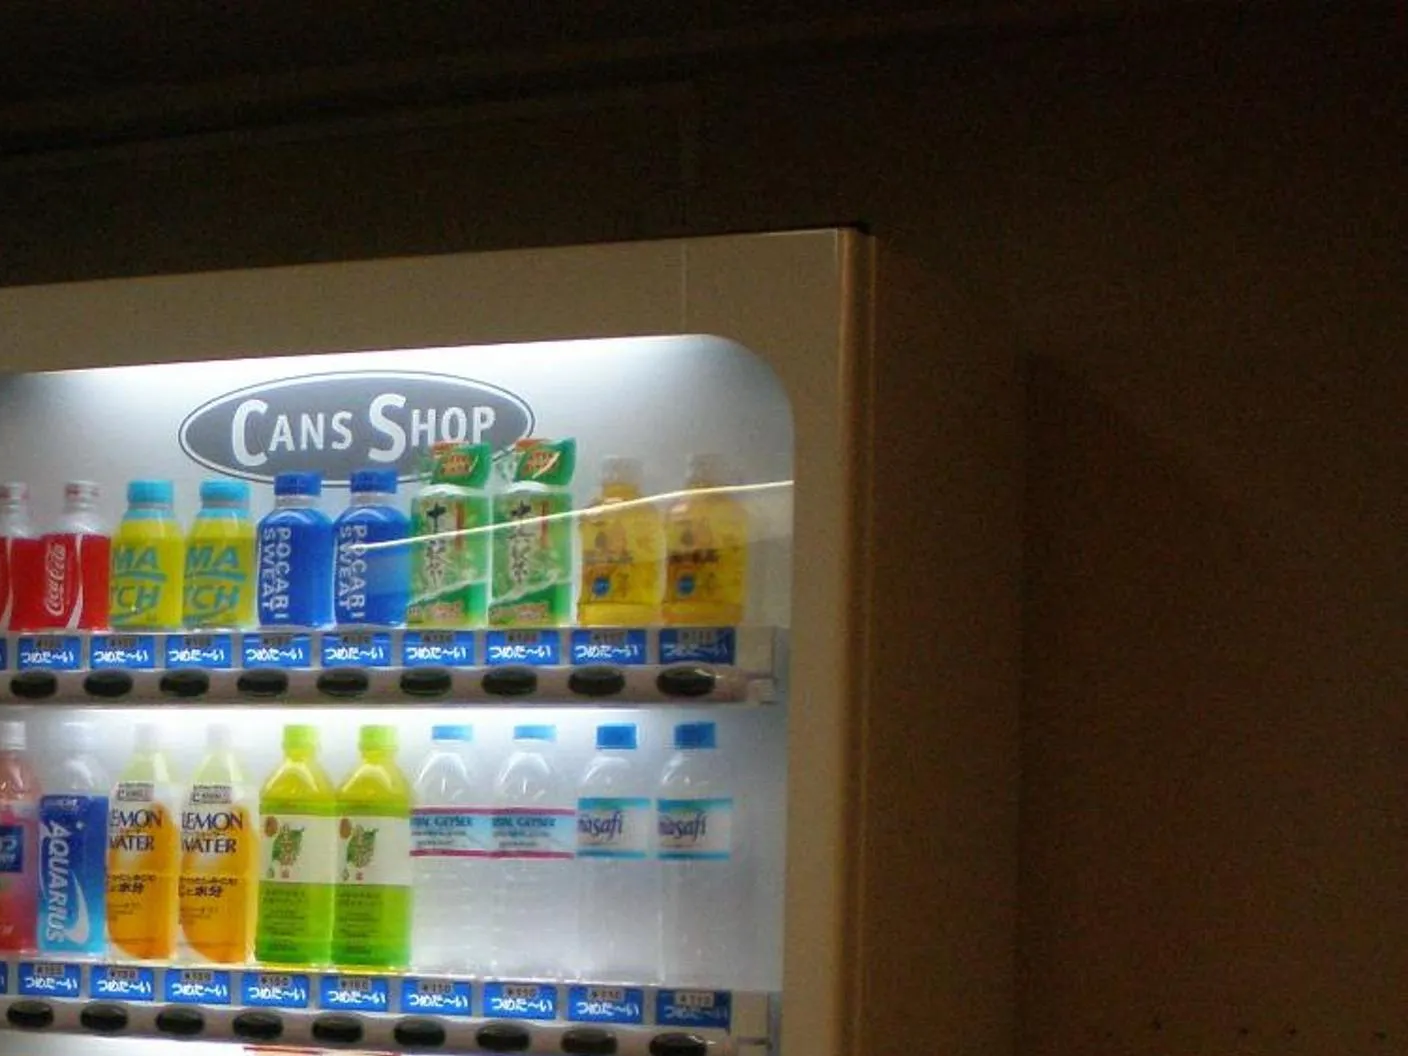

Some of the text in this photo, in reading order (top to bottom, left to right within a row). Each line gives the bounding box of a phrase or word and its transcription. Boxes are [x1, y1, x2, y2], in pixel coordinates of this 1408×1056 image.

[231, 392, 496, 467] CANS SHOP
[45, 541, 67, 617] Coca-Cola
[111, 585, 160, 609] CH
[261, 528, 276, 612] SWEAT
[272, 527, 291, 618] POCARI
[45, 819, 72, 944] AQUARIUS
